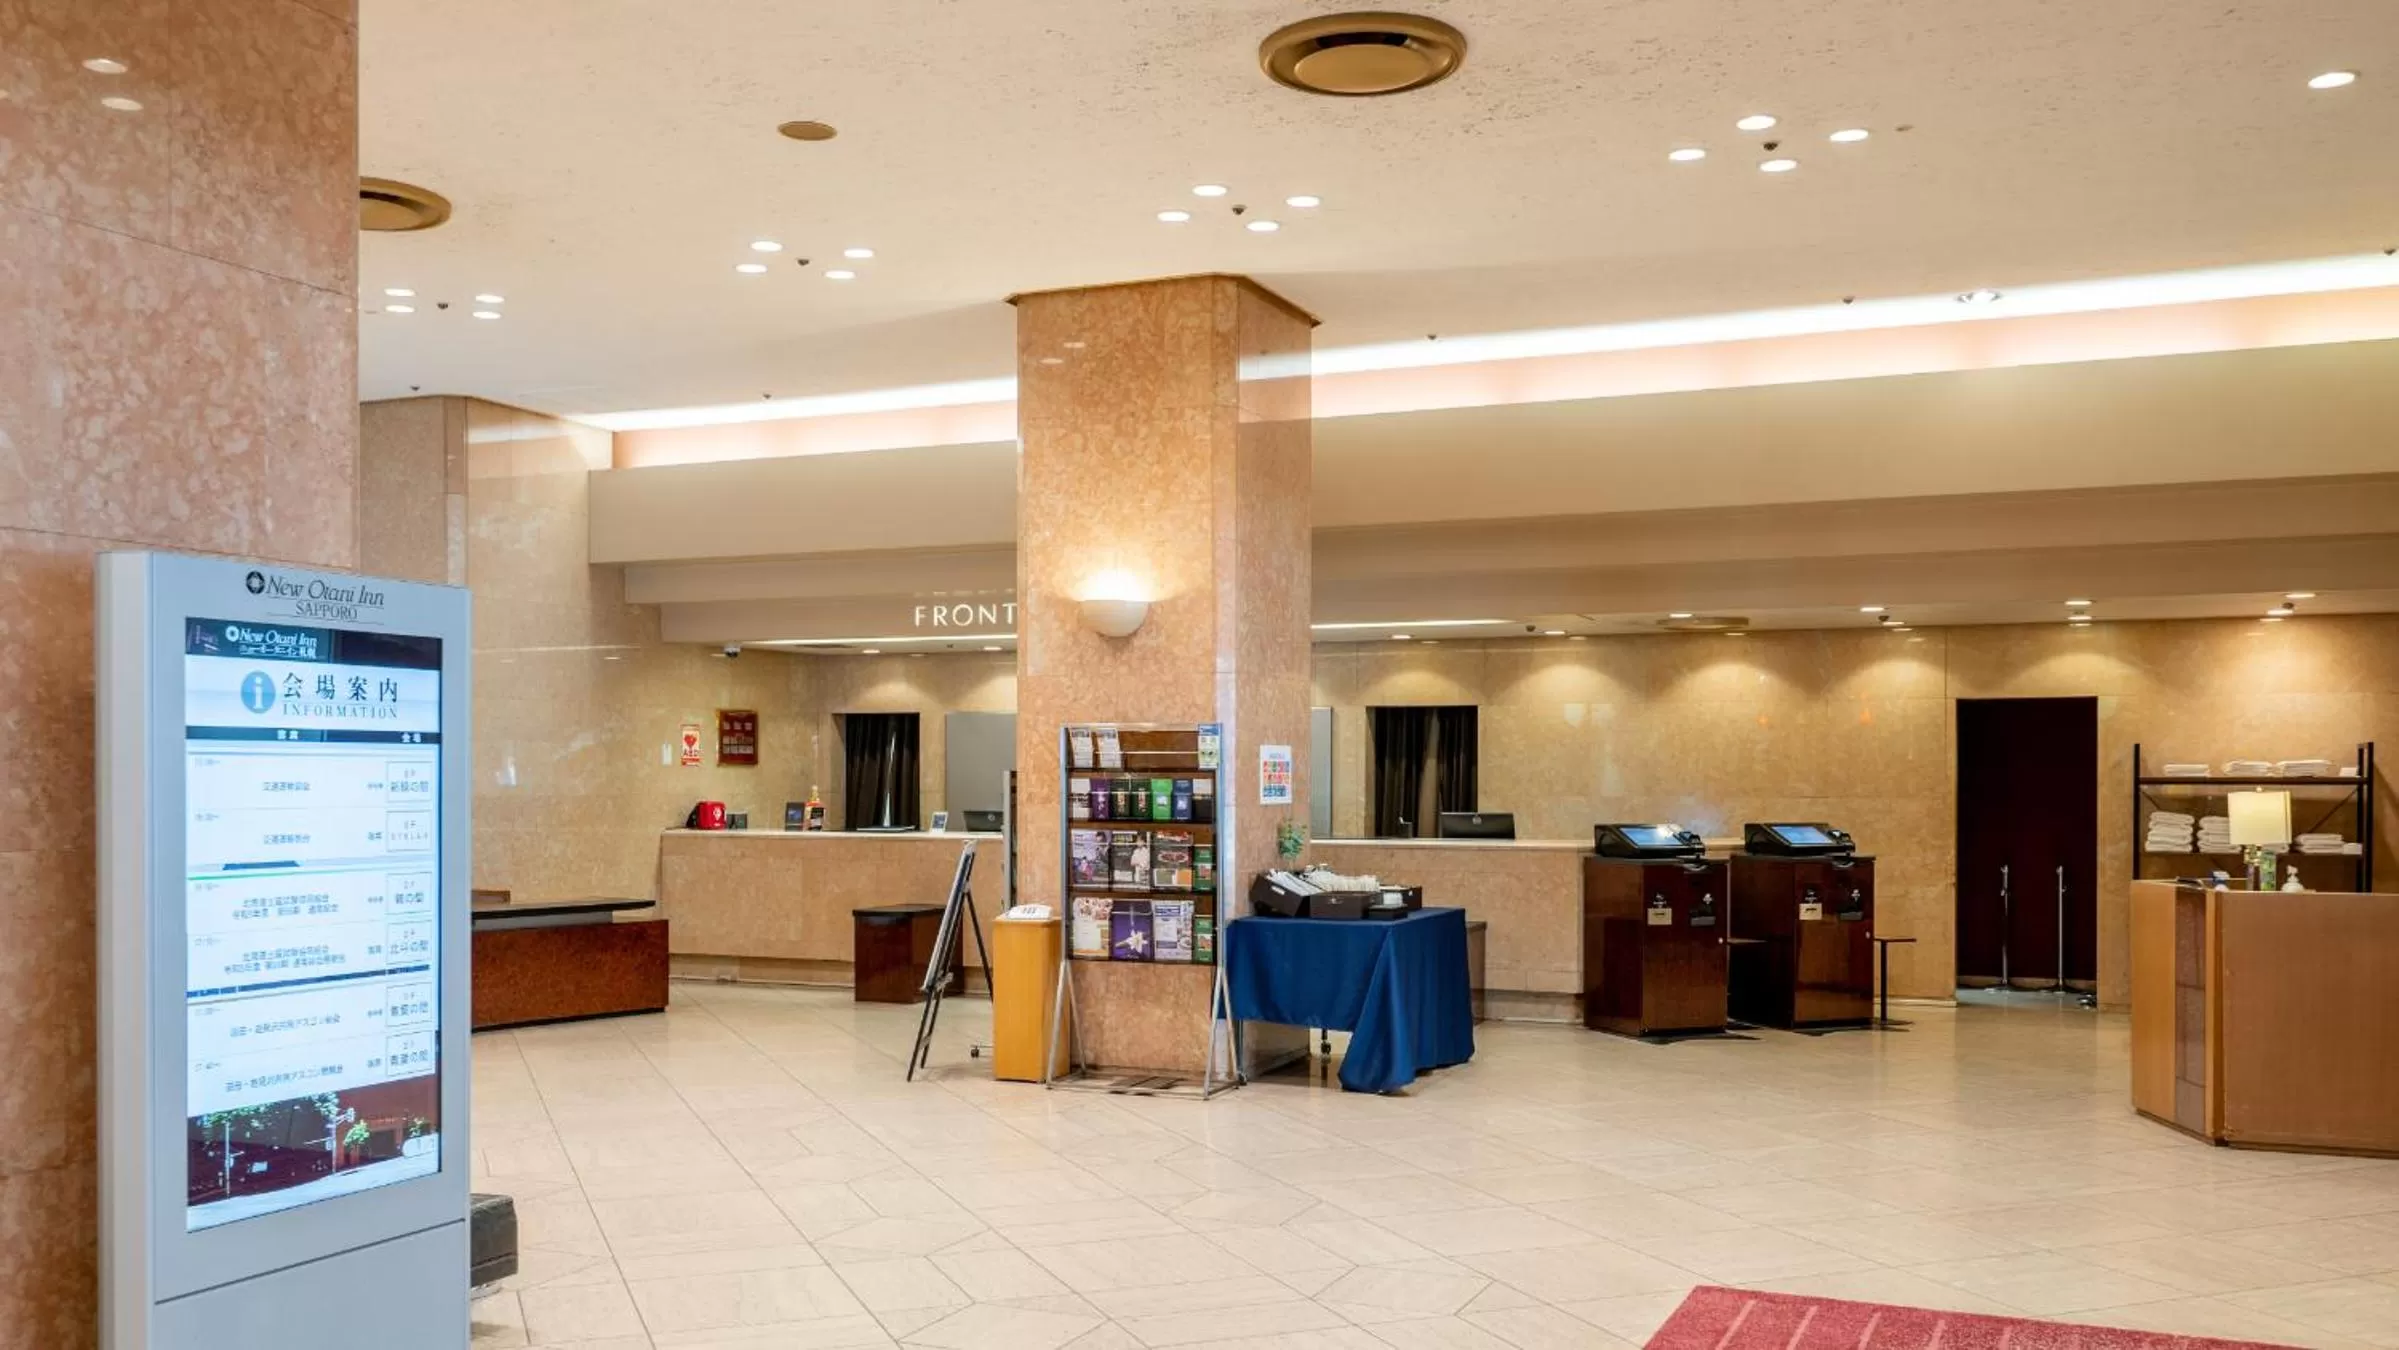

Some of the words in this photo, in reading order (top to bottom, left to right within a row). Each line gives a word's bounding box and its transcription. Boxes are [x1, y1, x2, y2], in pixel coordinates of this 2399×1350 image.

[266, 575, 304, 597] New
[308, 579, 355, 602] Otani
[358, 585, 384, 606] Inn
[295, 600, 358, 620] SAPPORO
[915, 603, 1017, 627] FRONT
[240, 627, 265, 642] New
[265, 630, 298, 645] Otani
[298, 632, 318, 647] Inn
[283, 671, 398, 703] 会場案内
[283, 703, 398, 719] INFORMATION
